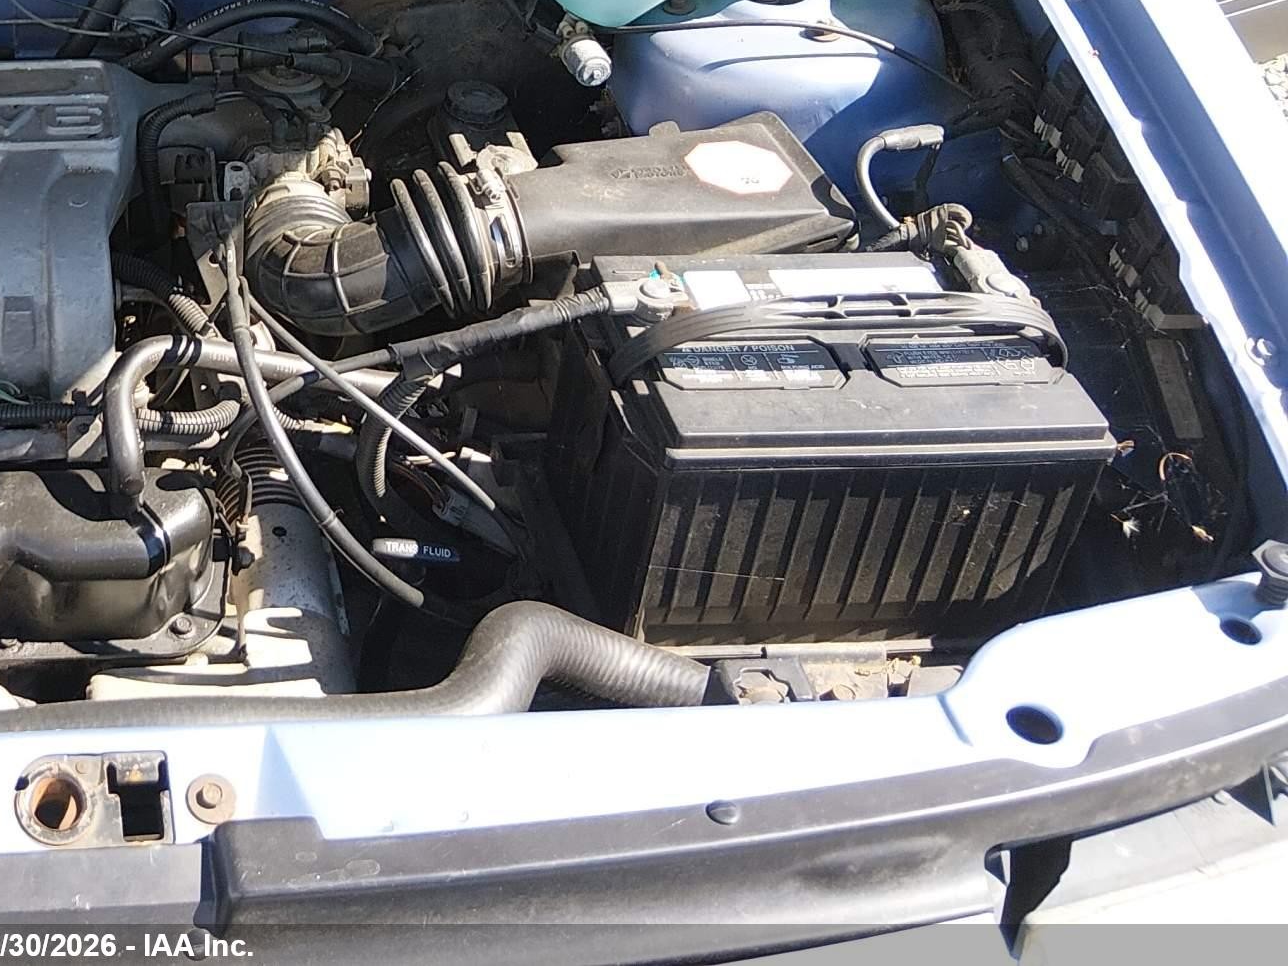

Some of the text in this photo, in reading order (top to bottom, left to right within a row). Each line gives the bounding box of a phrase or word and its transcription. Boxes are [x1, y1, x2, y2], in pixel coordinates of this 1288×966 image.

[694, 345, 741, 353] DANGER
[751, 344, 795, 352] POISON
[385, 541, 452, 558] TRANS FLUID
